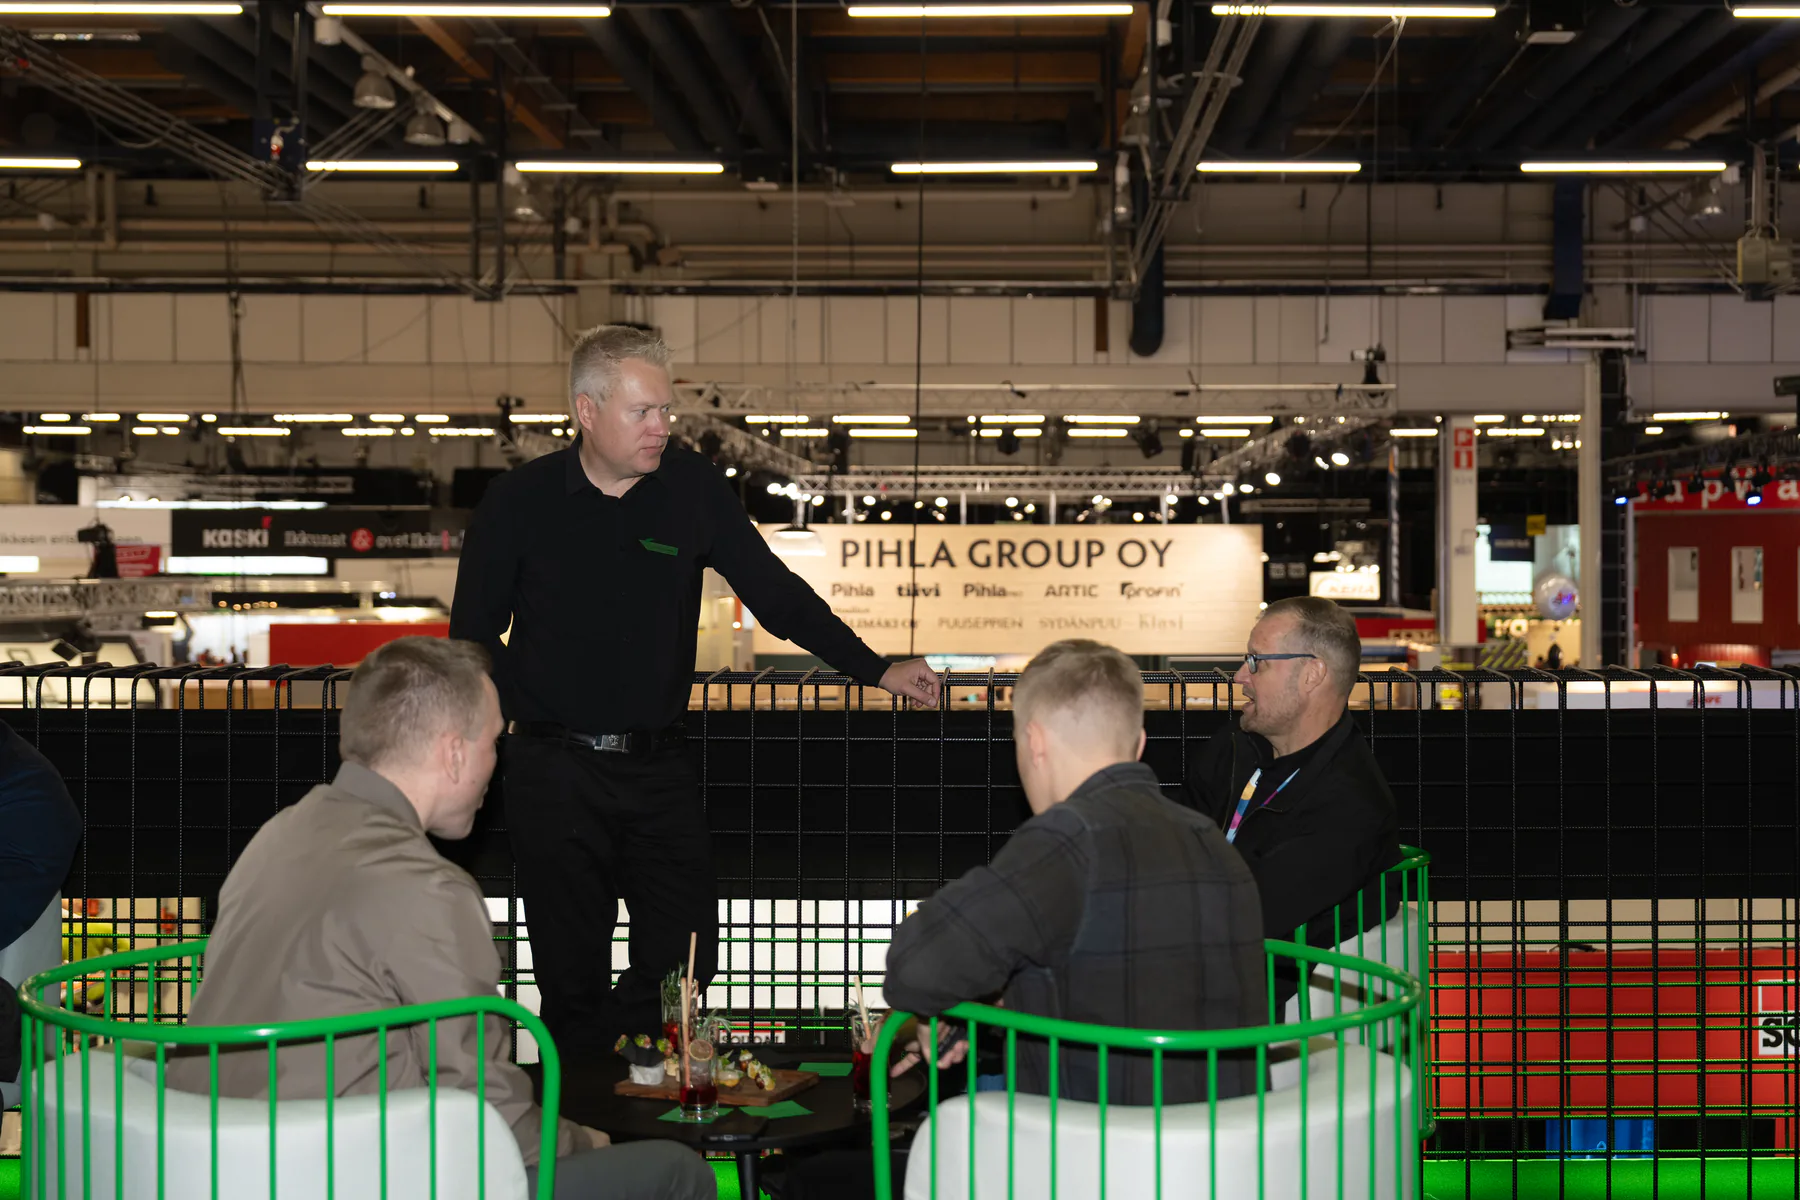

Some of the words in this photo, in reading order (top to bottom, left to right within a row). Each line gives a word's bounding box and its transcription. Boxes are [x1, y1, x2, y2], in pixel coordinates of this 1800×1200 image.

[841, 539, 957, 568] PIHLA
[968, 539, 1105, 568] GROUP
[1117, 539, 1173, 568] OY
[831, 583, 875, 597] Pihla
[963, 583, 1007, 597] Pihla
[1044, 584, 1099, 597] ARTIC
